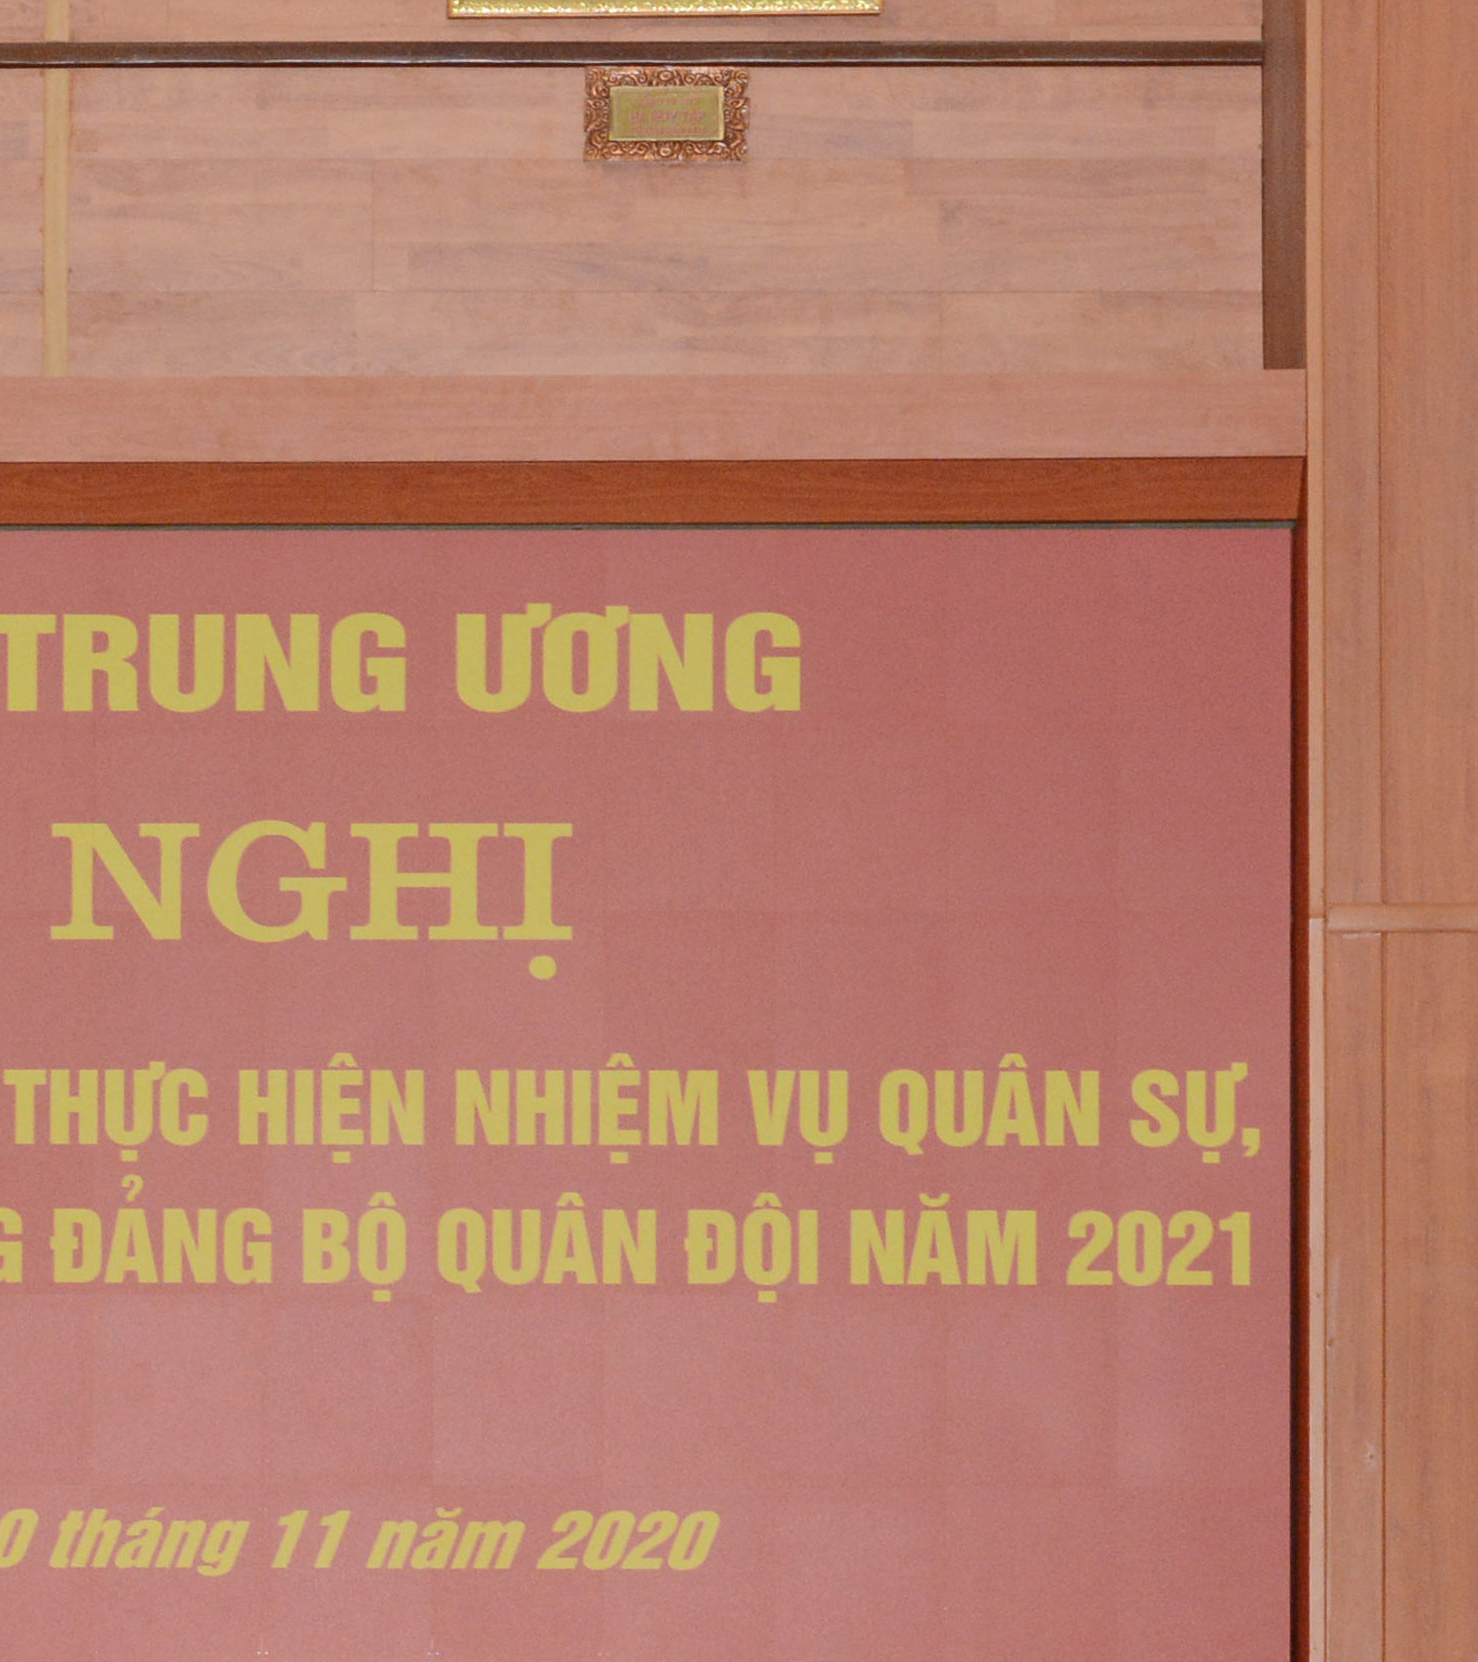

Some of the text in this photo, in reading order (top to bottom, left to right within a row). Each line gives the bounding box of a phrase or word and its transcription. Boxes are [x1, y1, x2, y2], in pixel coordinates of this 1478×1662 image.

[456, 602, 802, 713] ƯƠNG
[51, 820, 574, 979] NGHỊ
[5, 1061, 209, 1162] THỰC
[239, 1052, 425, 1163] HIỆN
[455, 1053, 719, 1163] NHIỆM
[748, 1070, 849, 1164] VỤ
[879, 1053, 1100, 1155] QUÂN
[1130, 1062, 1261, 1164] SỰ,
[49, 1174, 273, 1284] ĐẢNG
[303, 1192, 407, 1302] BỘ
[438, 1192, 658, 1293] QUÂN
[684, 1192, 820, 1303] ĐỘI
[850, 1193, 1038, 1285] NĂM
[1067, 1210, 1252, 1286] 2021
[49, 1507, 250, 1576] tháng
[271, 1510, 351, 1568] 11
[366, 1507, 526, 1570] năm
[537, 1510, 721, 1570] 2020
